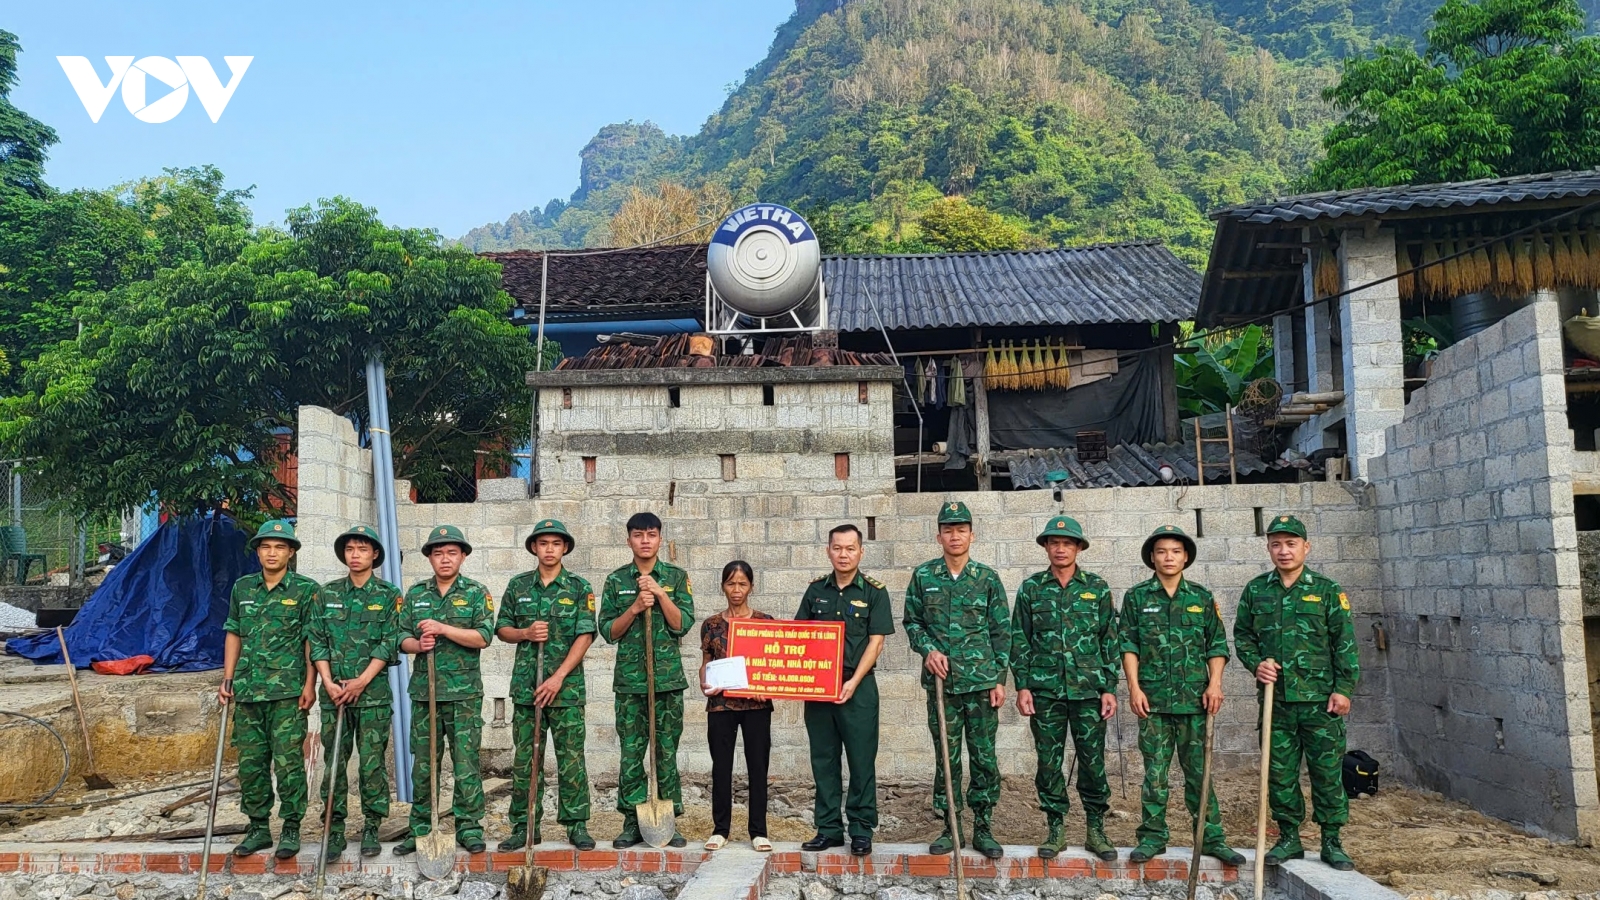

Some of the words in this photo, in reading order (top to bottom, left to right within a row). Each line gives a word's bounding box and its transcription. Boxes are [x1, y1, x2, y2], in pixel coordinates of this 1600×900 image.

[722, 207, 806, 239] VIETHA
[764, 642, 780, 654] HỖ
[784, 644, 806, 657] TRỢ
[818, 660, 832, 669] NÁT
[752, 671, 760, 680] SỐ
